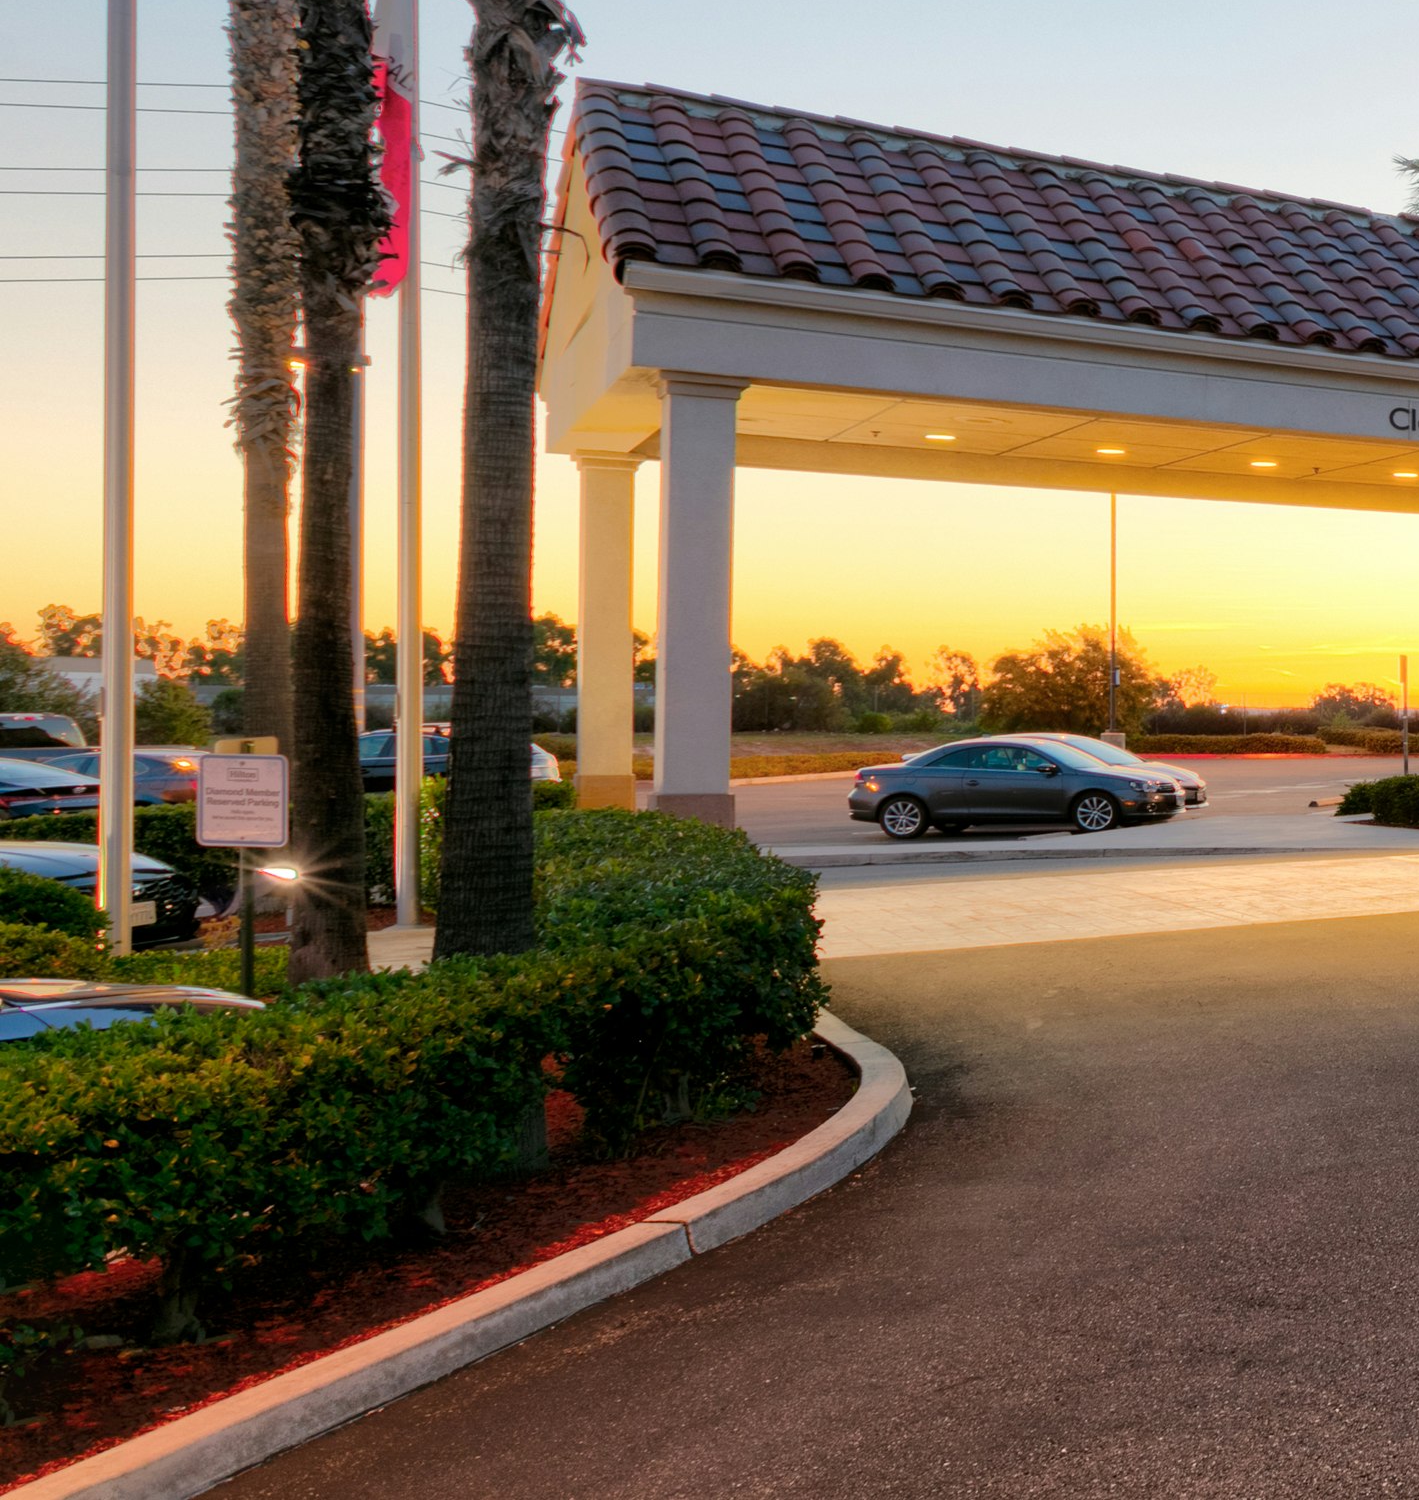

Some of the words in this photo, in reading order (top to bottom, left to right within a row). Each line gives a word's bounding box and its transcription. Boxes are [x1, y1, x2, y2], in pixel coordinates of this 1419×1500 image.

[230, 770, 257, 779] Hilton
[205, 787, 244, 796] Diamond
[246, 788, 280, 797] Member
[206, 796, 246, 806] Reserved
[247, 798, 279, 809] Parking
